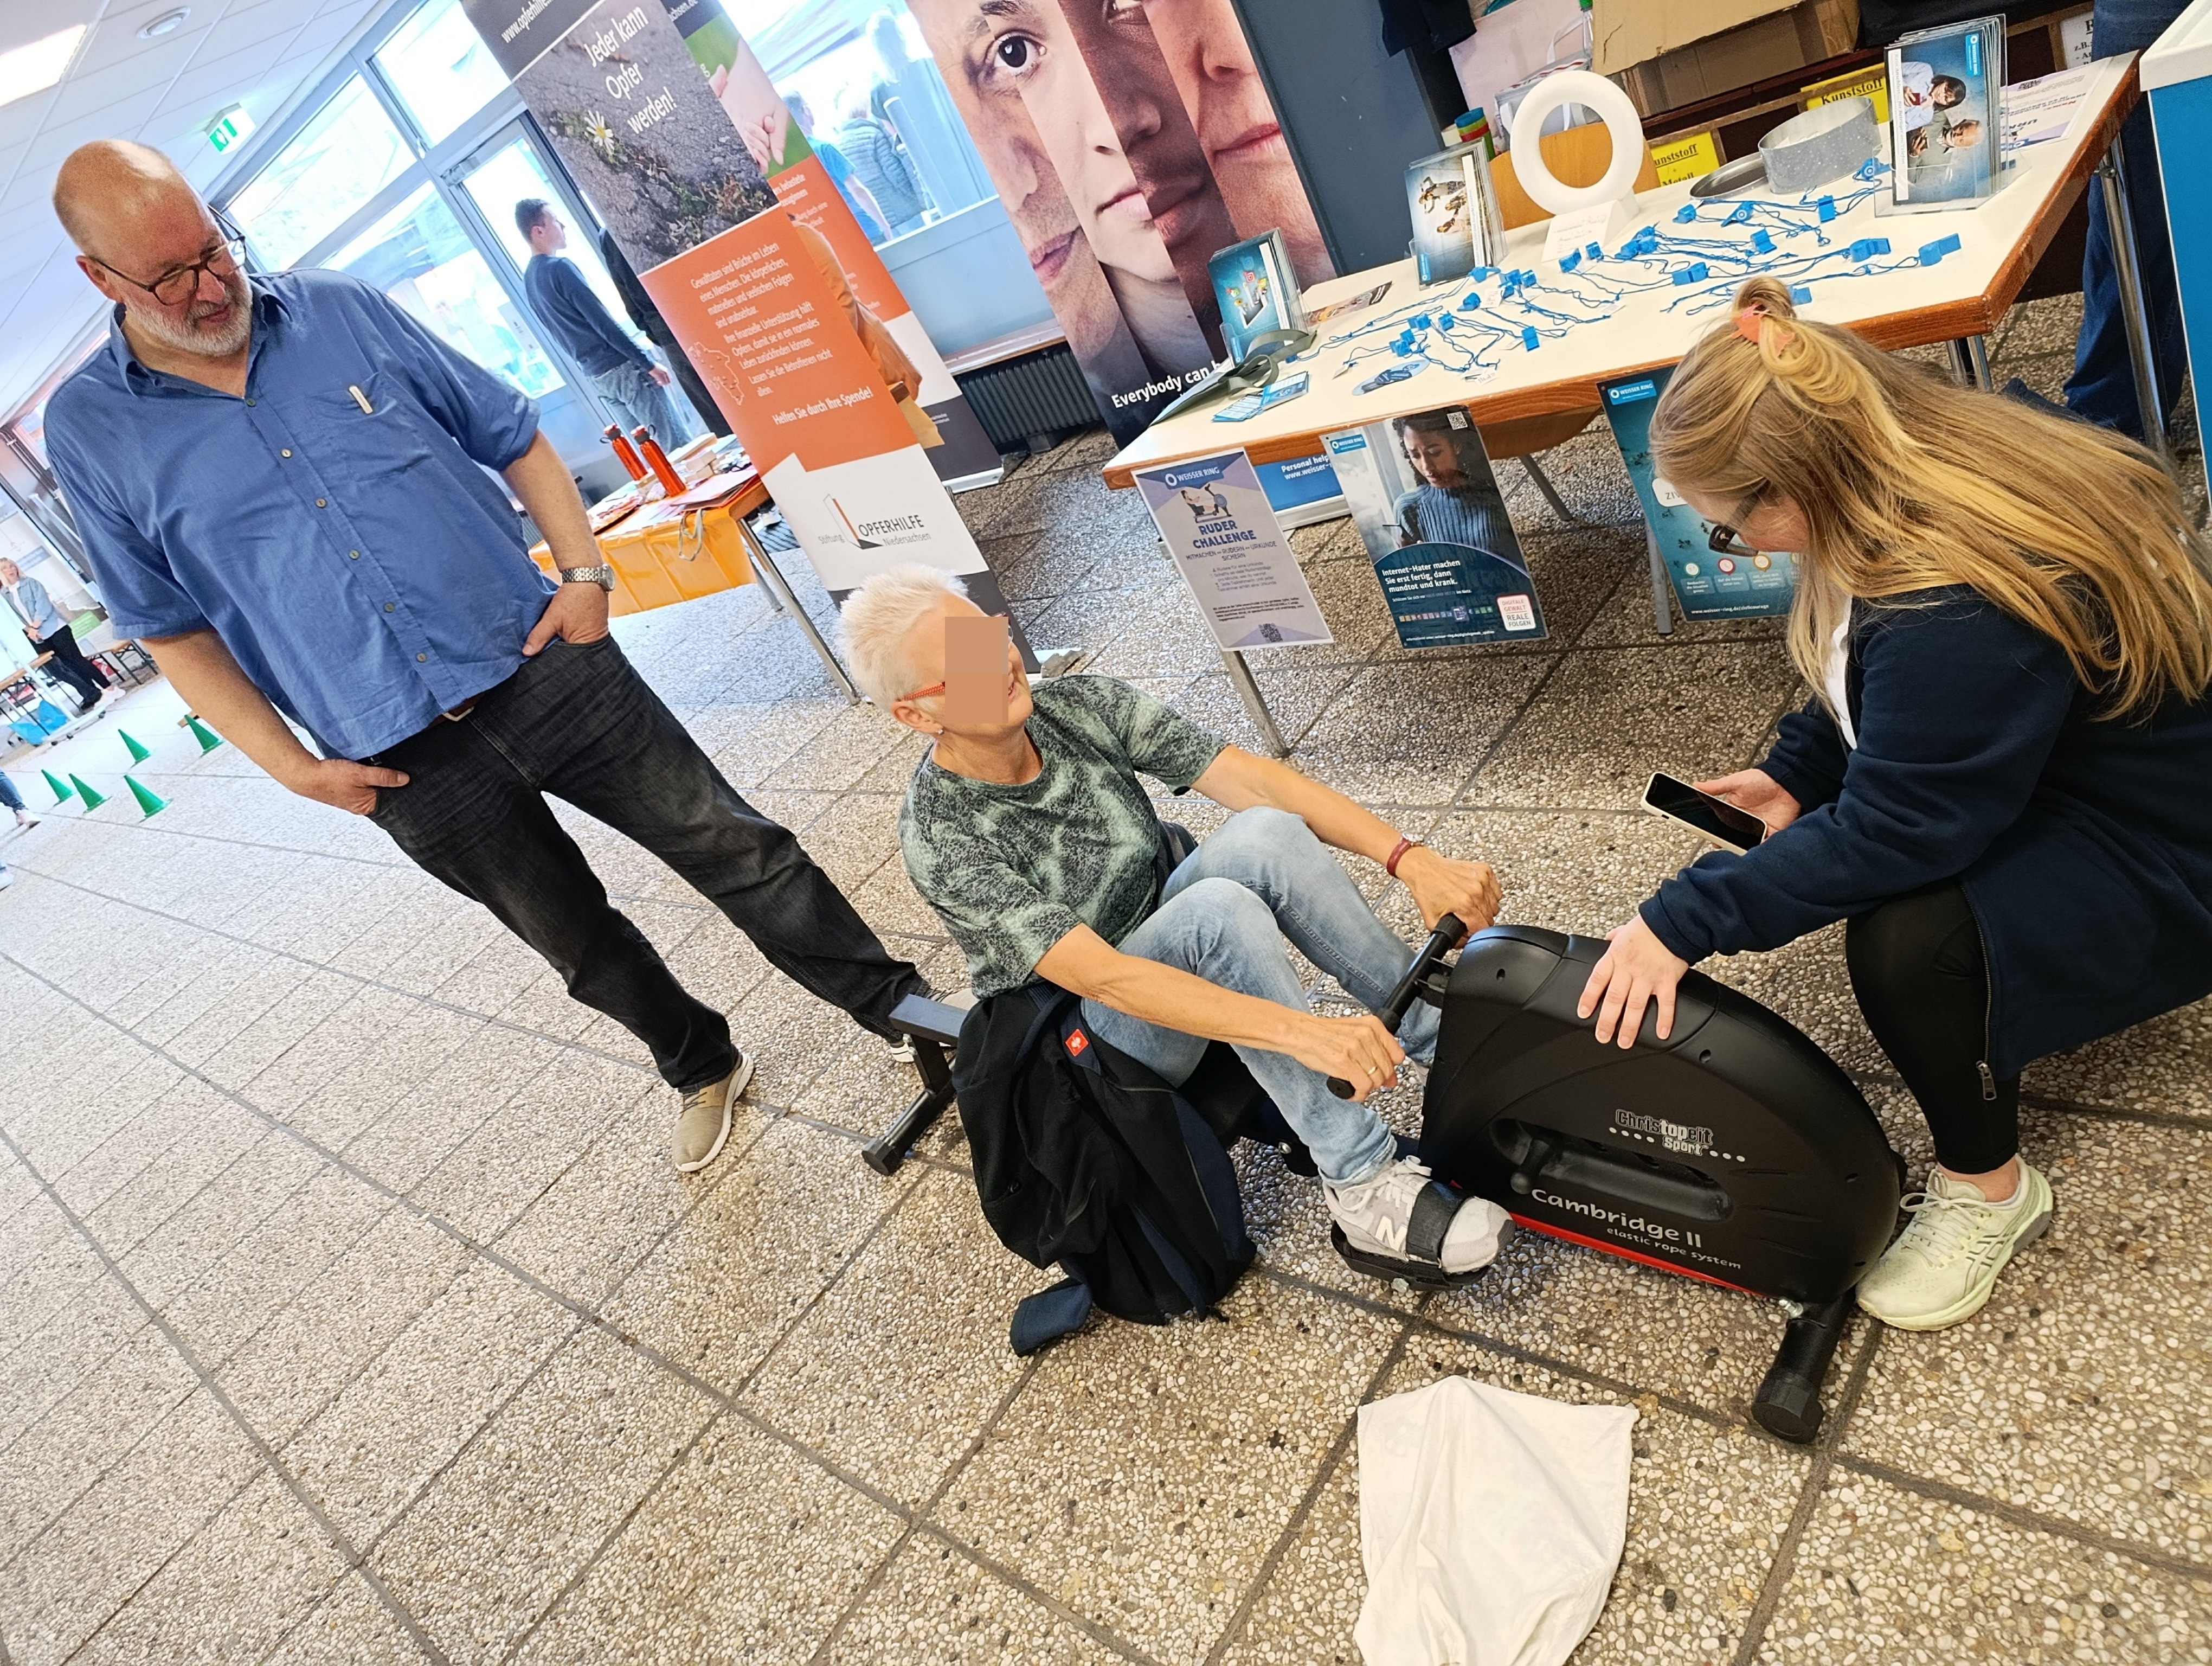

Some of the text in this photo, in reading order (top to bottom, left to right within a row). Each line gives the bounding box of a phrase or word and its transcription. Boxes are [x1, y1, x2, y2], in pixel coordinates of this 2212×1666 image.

[584, 7, 648, 67] Jeder kann
[606, 62, 643, 100] Opfer
[1821, 78, 1882, 105] Kunststoff
[627, 86, 677, 134] werden!
[1655, 144, 1696, 165] unststoff
[722, 261, 735, 275] sind
[732, 255, 753, 270] Brüche
[750, 252, 761, 261] im
[758, 243, 779, 258] Leben
[700, 291, 714, 302] eines
[712, 279, 742, 296] Menschen.
[740, 273, 752, 284] Die
[708, 298, 736, 315] materiellen
[735, 291, 748, 304] und
[771, 273, 794, 287] Folgen
[715, 316, 728, 328] sind
[724, 334, 736, 343] Ihre
[760, 309, 802, 329] Unterstützung
[753, 336, 770, 349] damit
[769, 334, 777, 343] sie
[775, 331, 784, 339] in
[783, 328, 793, 337] ein
[793, 318, 819, 334] normales
[740, 358, 757, 369] Leben
[789, 338, 814, 351] können.
[748, 349, 833, 384] Lassen Sie die Betroffenen nicht
[1111, 375, 1182, 408] Everybody
[1185, 367, 1210, 383] can
[1619, 387, 1640, 395] WEISSER
[772, 386, 873, 425] Helfen Sie durch Ihre Spende!
[1176, 467, 1220, 482] WEISSER RING
[1281, 458, 1312, 472] Personal
[818, 533, 931, 546] Stiftung Niedersachsen
[859, 515, 924, 536] OPFERHILFE
[1193, 530, 1257, 549] CHALLENGE
[1198, 520, 1237, 535] RUDER
[1186, 551, 1216, 561] MITMACHEN
[1250, 541, 1277, 550] URKUNDE
[1382, 560, 1461, 576] Internet-Hater machen
[1411, 572, 1433, 580] fertig,
[1389, 583, 1418, 593] mundtot
[1616, 1109, 1713, 1145] Christopeit
[1532, 1189, 1701, 1248] Cambridge II
[1607, 1227, 1741, 1269] elastic rope system
